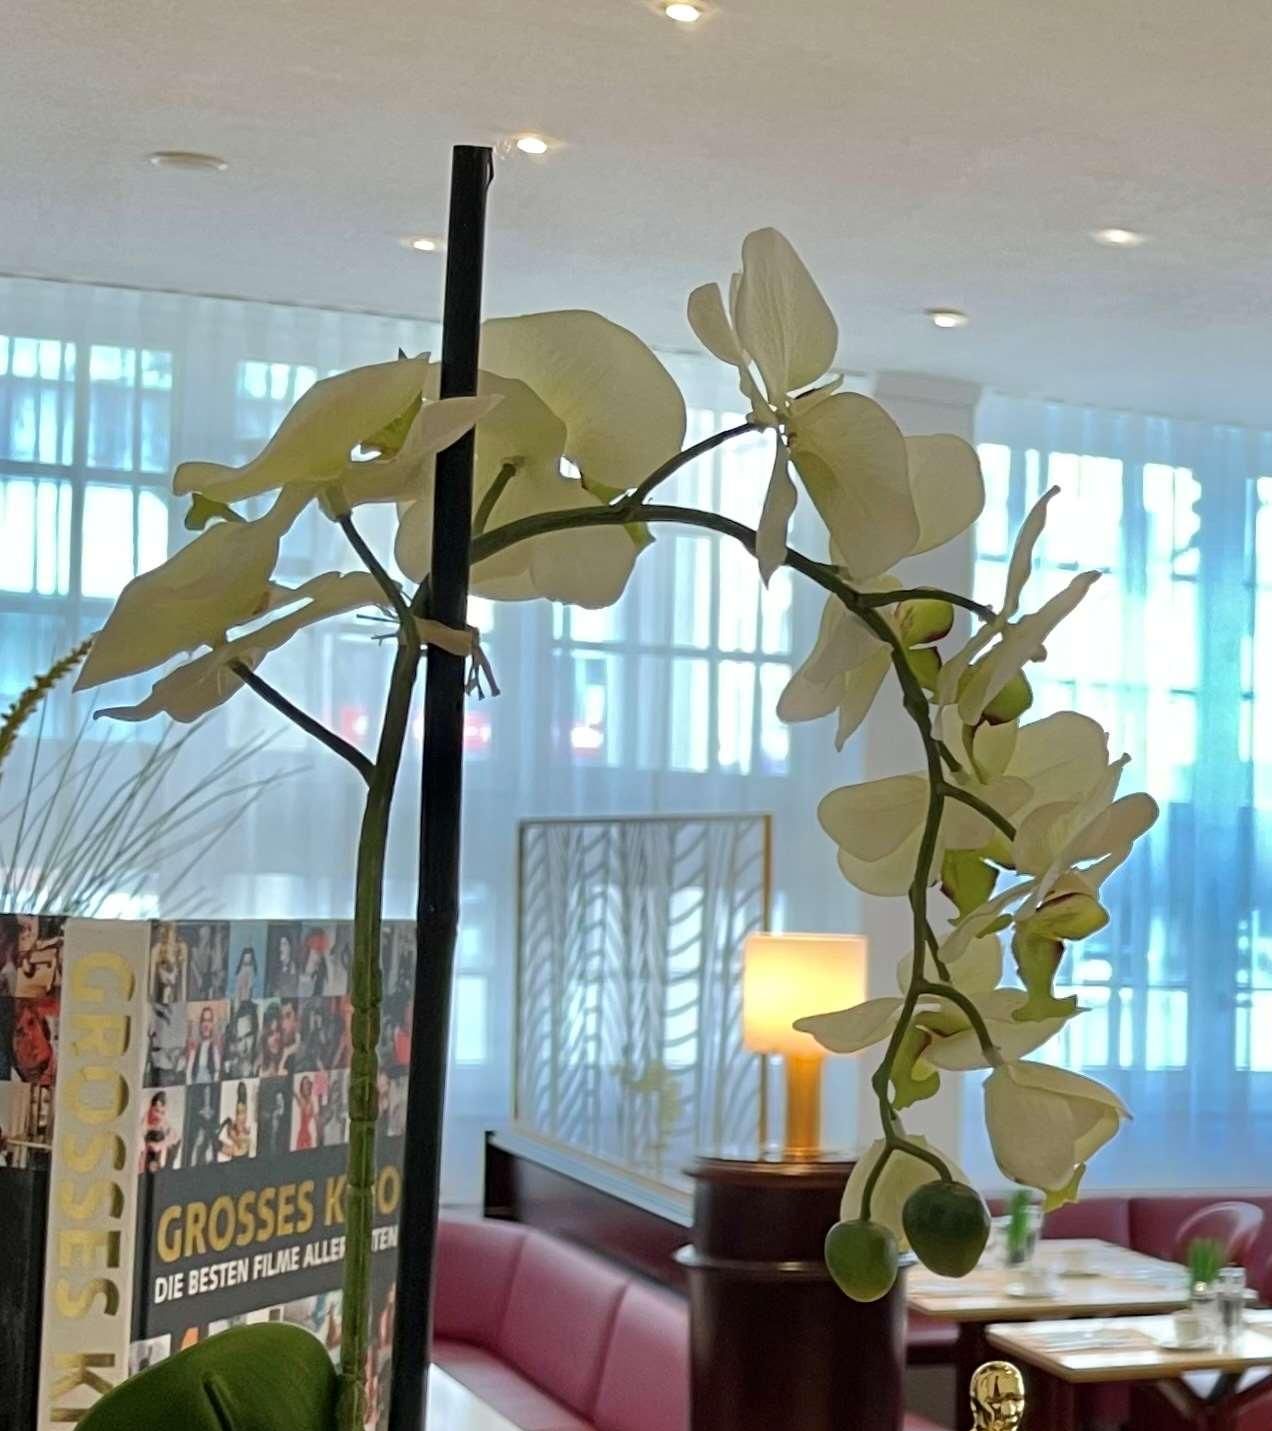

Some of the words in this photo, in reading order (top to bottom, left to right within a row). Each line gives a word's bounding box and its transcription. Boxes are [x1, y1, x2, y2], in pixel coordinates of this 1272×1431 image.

[55, 951, 135, 1318] GROSSES
[157, 1179, 315, 1264] GROSSES
[324, 1165, 400, 1227] KO
[154, 1270, 184, 1304] DIE
[187, 1257, 249, 1296] BESTEN
[252, 1251, 300, 1281] FILME
